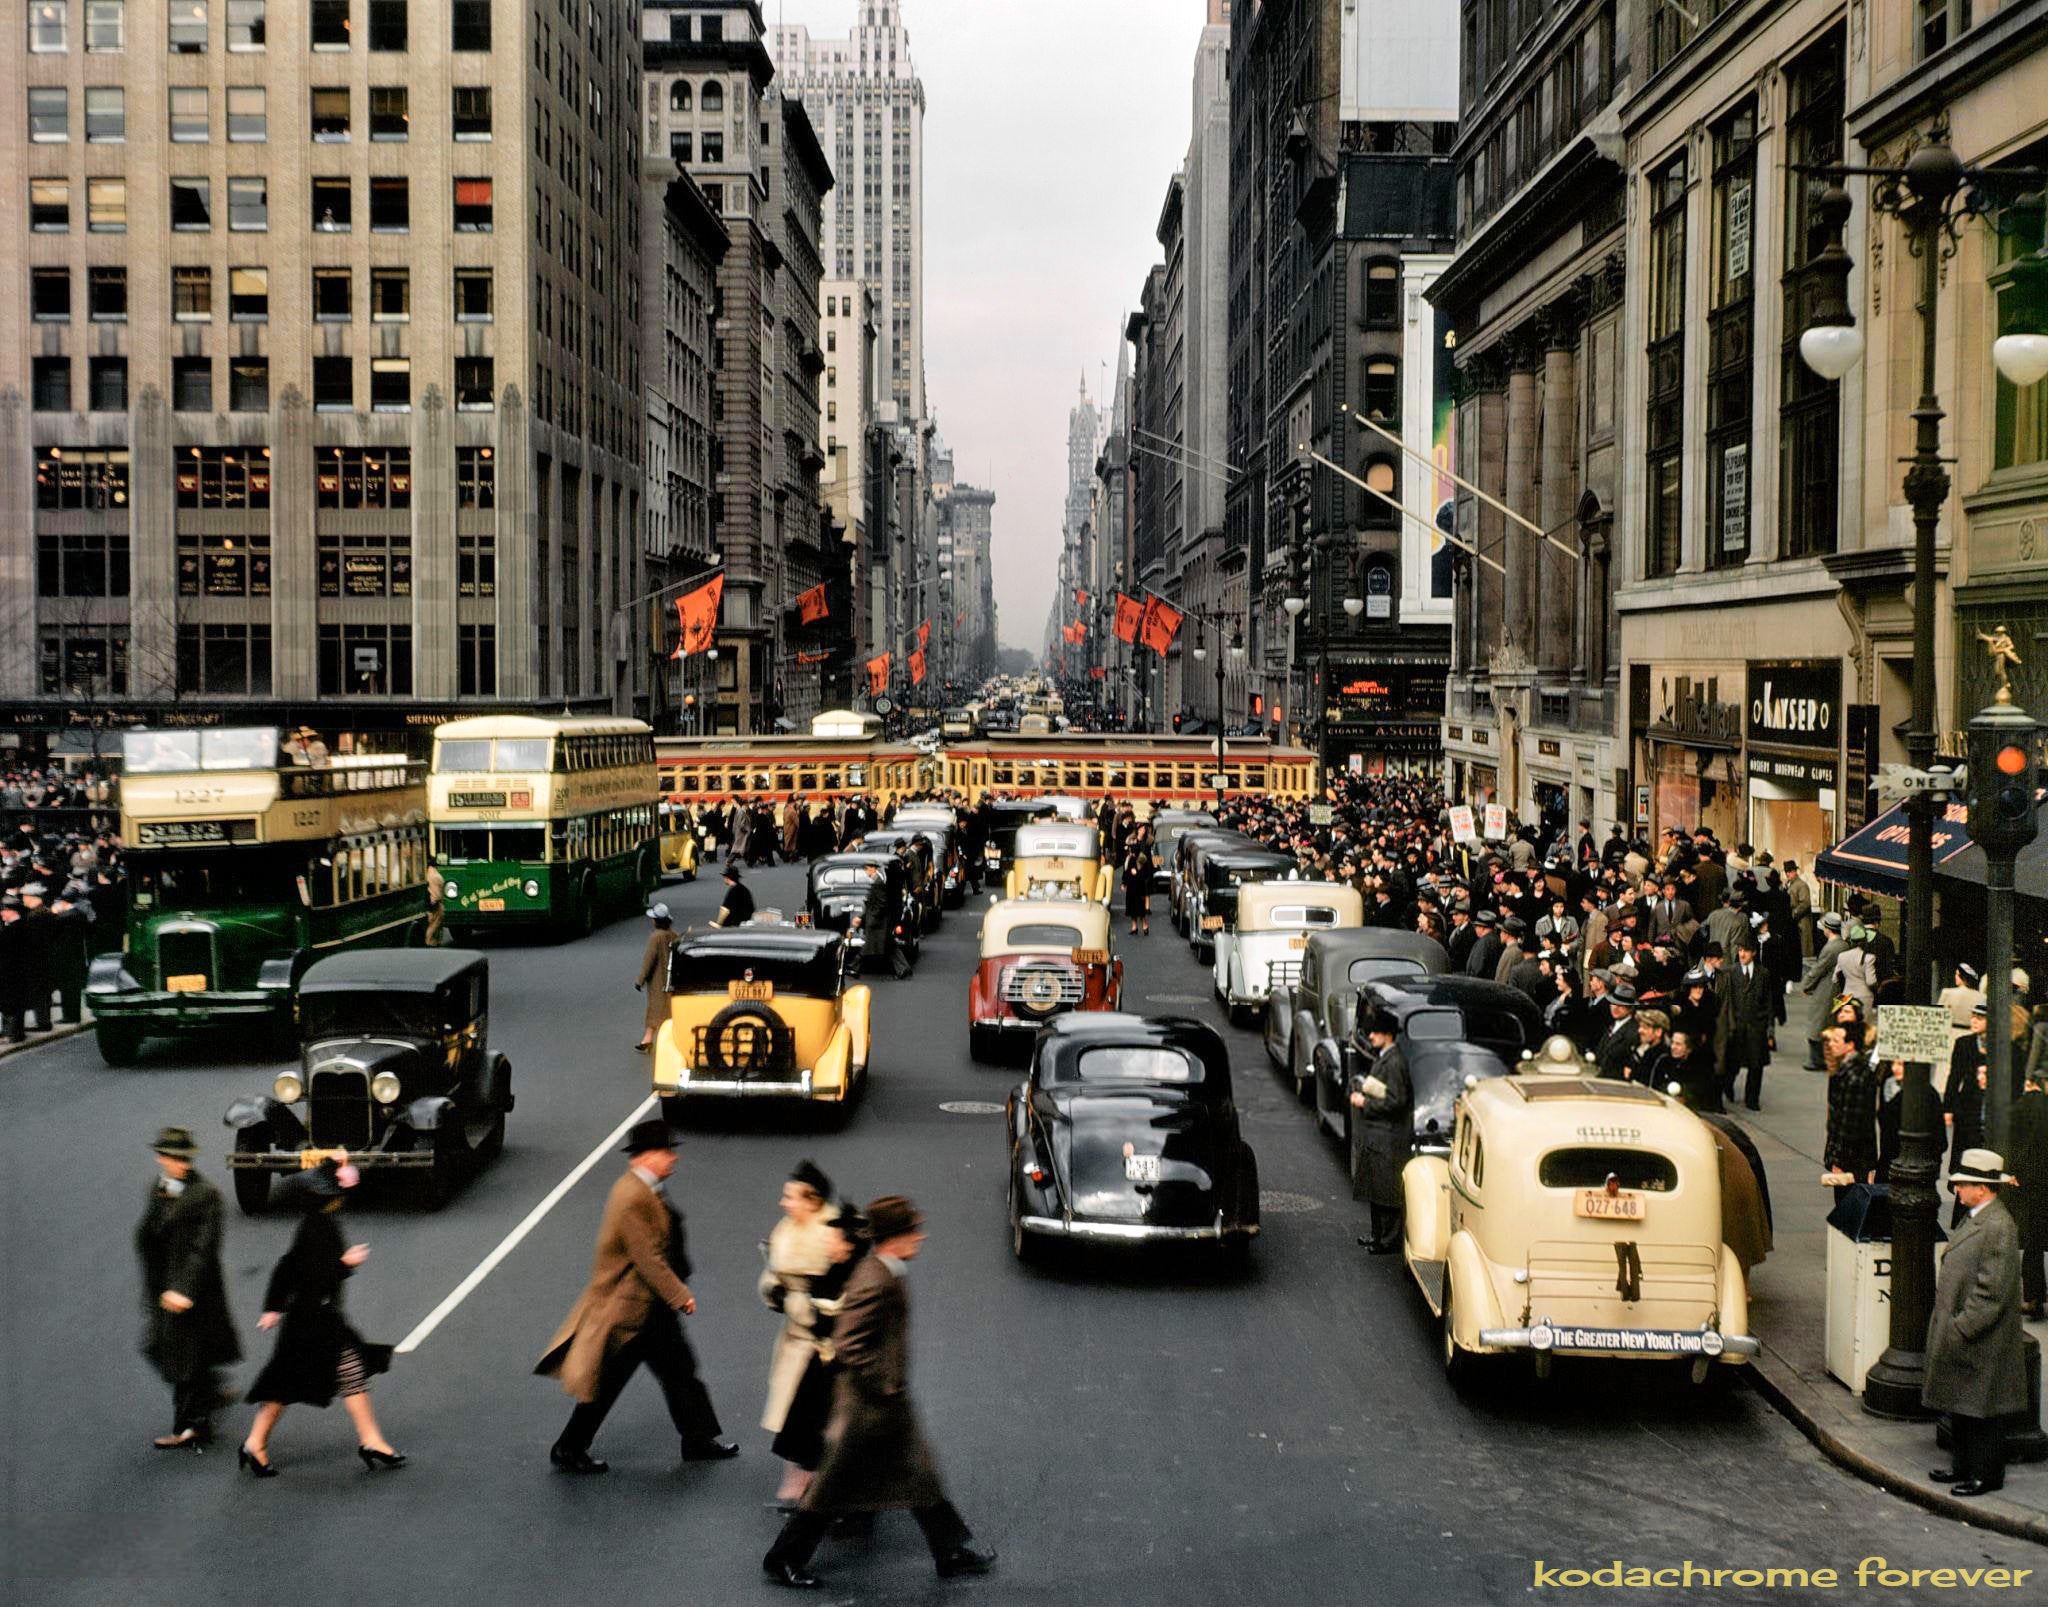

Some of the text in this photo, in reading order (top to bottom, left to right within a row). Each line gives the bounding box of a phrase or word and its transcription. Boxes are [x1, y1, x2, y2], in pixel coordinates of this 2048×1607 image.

[1763, 681, 1816, 731] KAYSER
[406, 714, 448, 725] SHERMAN
[1774, 761, 1805, 778] UNDERWEAR
[1811, 767, 1833, 782] GLOVES
[1904, 777, 1937, 788] ONE
[1880, 1007, 1951, 1019] NO PARKING
[1614, 1200, 1637, 1215] 648
[1553, 1329, 1574, 1347] THE
[1574, 1329, 1620, 1348] GREATER
[1620, 1330, 1645, 1349] NEW
[1644, 1331, 1673, 1350] YORK
[1673, 1332, 1701, 1351] FUND
